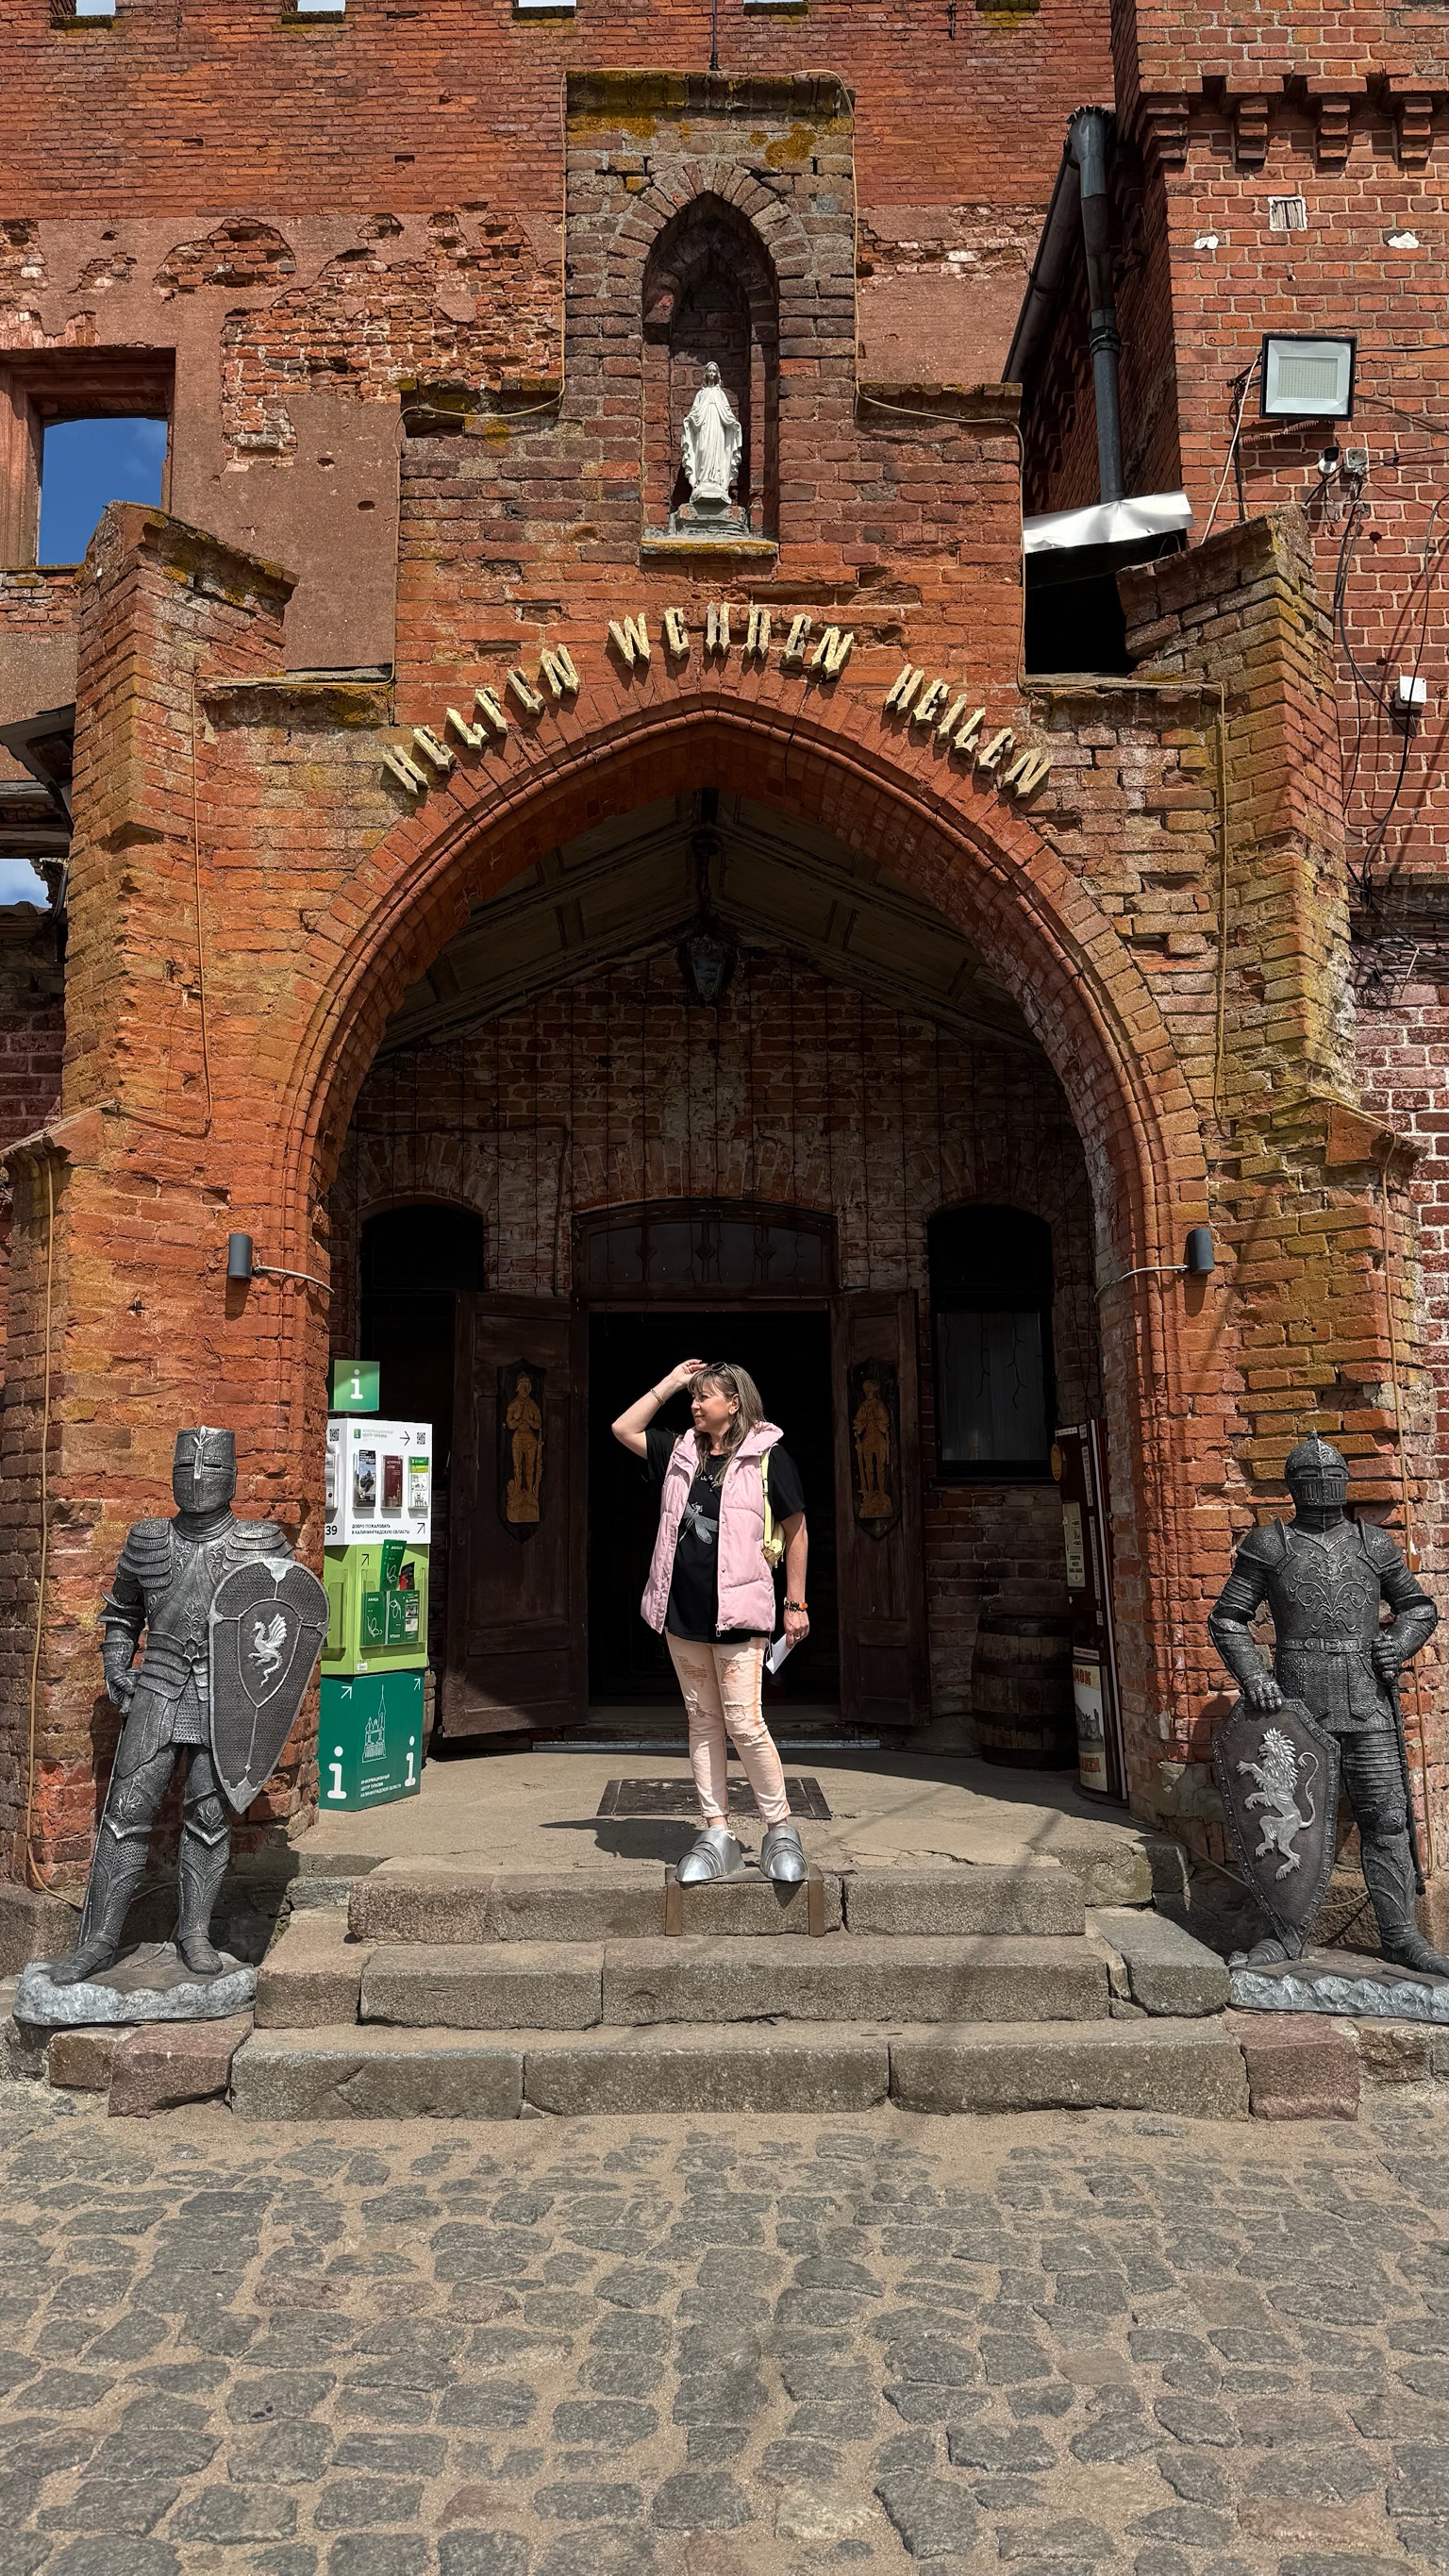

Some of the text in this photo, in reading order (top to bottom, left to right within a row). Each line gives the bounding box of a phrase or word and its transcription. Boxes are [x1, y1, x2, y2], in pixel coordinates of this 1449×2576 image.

[381, 602, 1052, 799] HELFEN WEHREN HEILEN
[350, 1368, 364, 1399] i
[325, 1525, 338, 1535] 39
[327, 1746, 347, 1799] i
[405, 1736, 416, 1786] i
